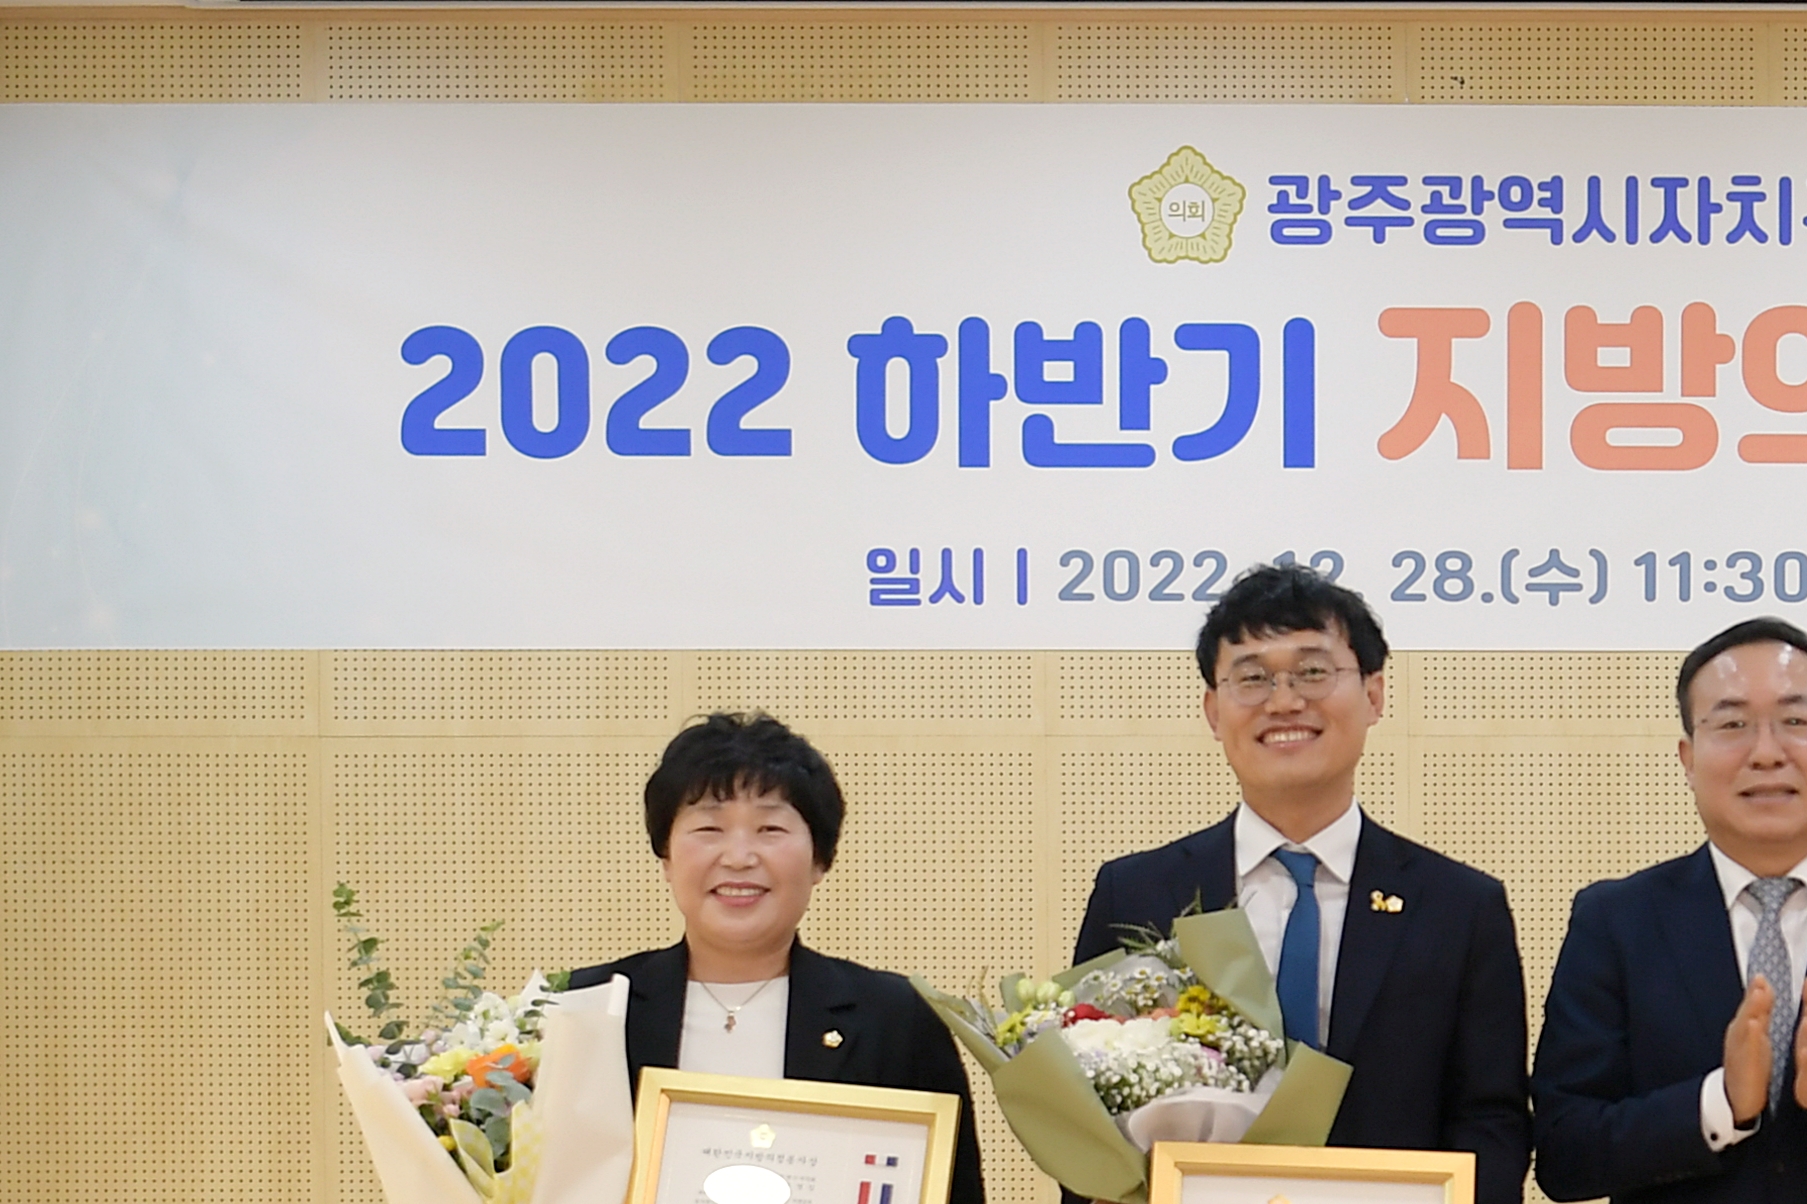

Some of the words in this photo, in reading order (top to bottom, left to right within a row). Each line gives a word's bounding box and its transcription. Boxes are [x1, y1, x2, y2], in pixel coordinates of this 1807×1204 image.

[1168, 200, 1205, 222] 의회
[400, 325, 793, 459] 2022
[847, 316, 1316, 470] 하반기
[865, 547, 985, 607] 일시
[1390, 548, 1608, 606] 28.(수)
